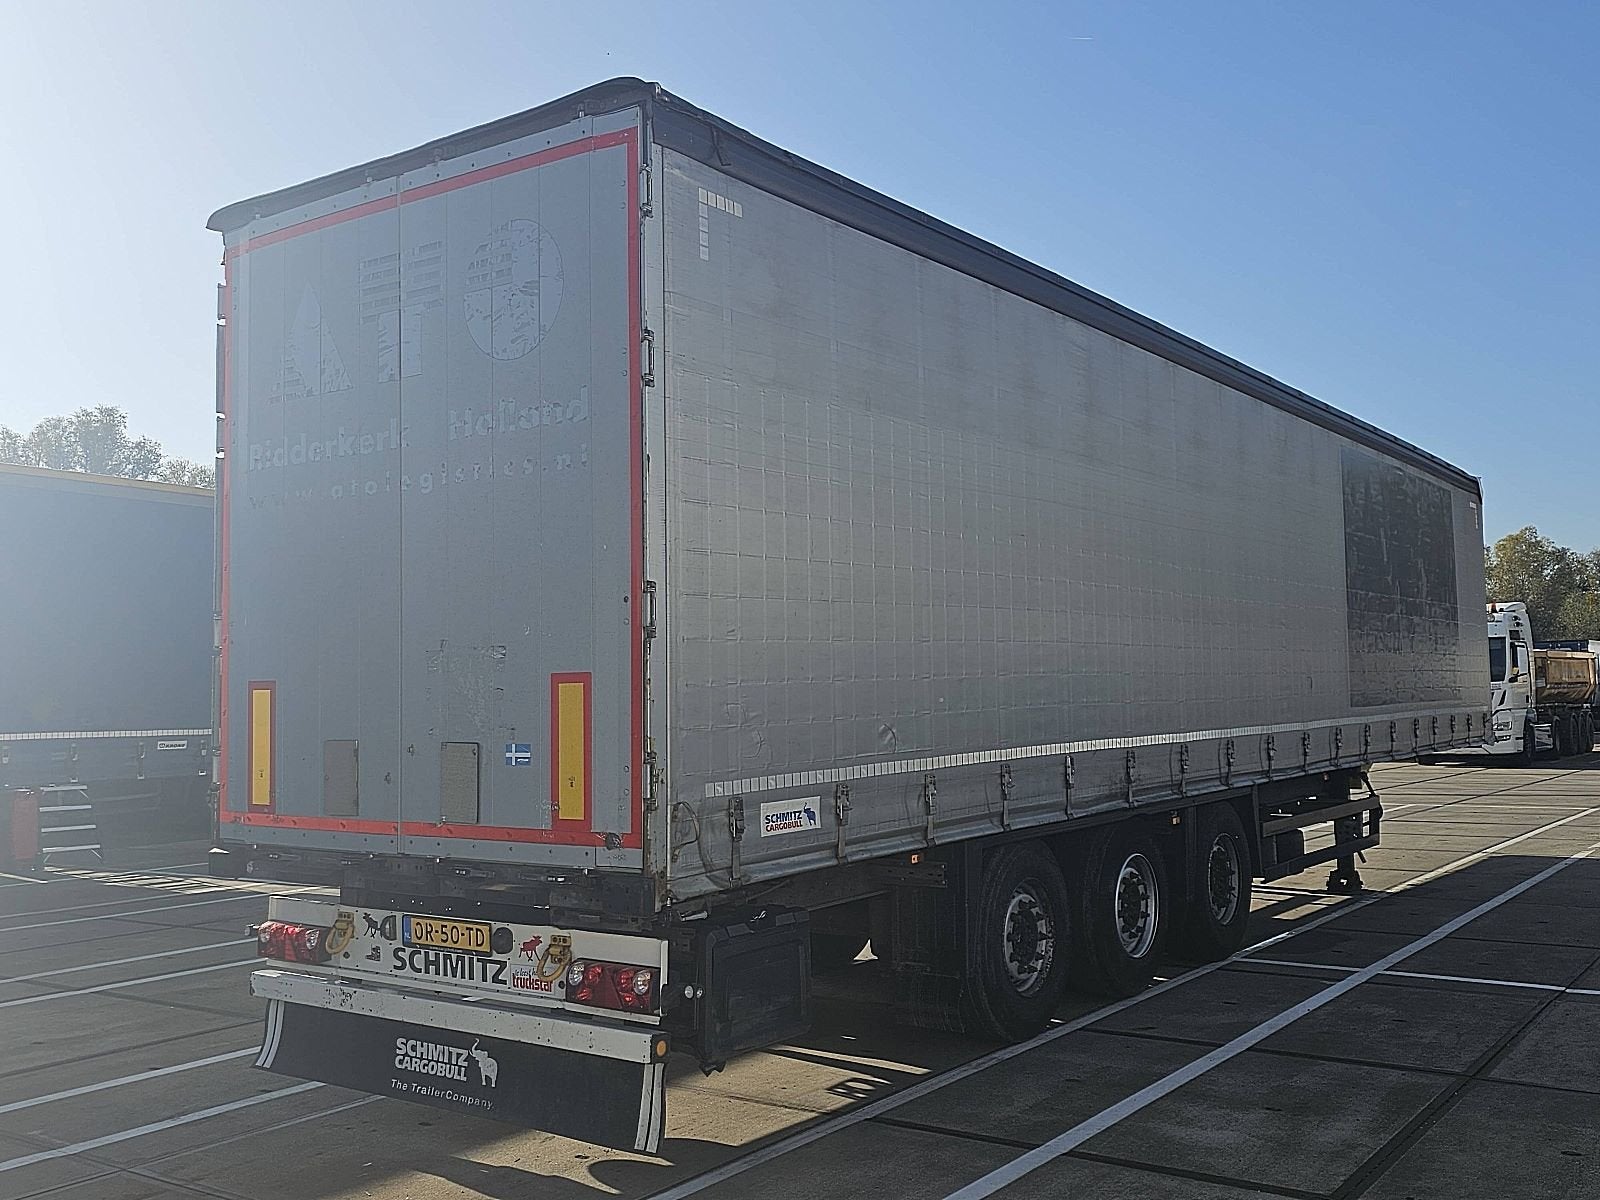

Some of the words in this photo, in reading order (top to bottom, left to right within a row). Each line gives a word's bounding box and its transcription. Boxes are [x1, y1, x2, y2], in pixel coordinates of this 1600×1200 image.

[765, 810, 802, 825] SCHMITZ
[765, 820, 803, 832] CARGOBULL
[414, 921, 485, 947] OR-50-TD
[392, 946, 508, 985] SCHMITZ
[512, 973, 553, 992] truckstar
[396, 1037, 468, 1067] SCHMITZ
[395, 1055, 467, 1082] CARGOBULL
[391, 1078, 408, 1091] The
[411, 1083, 445, 1098] Trailer
